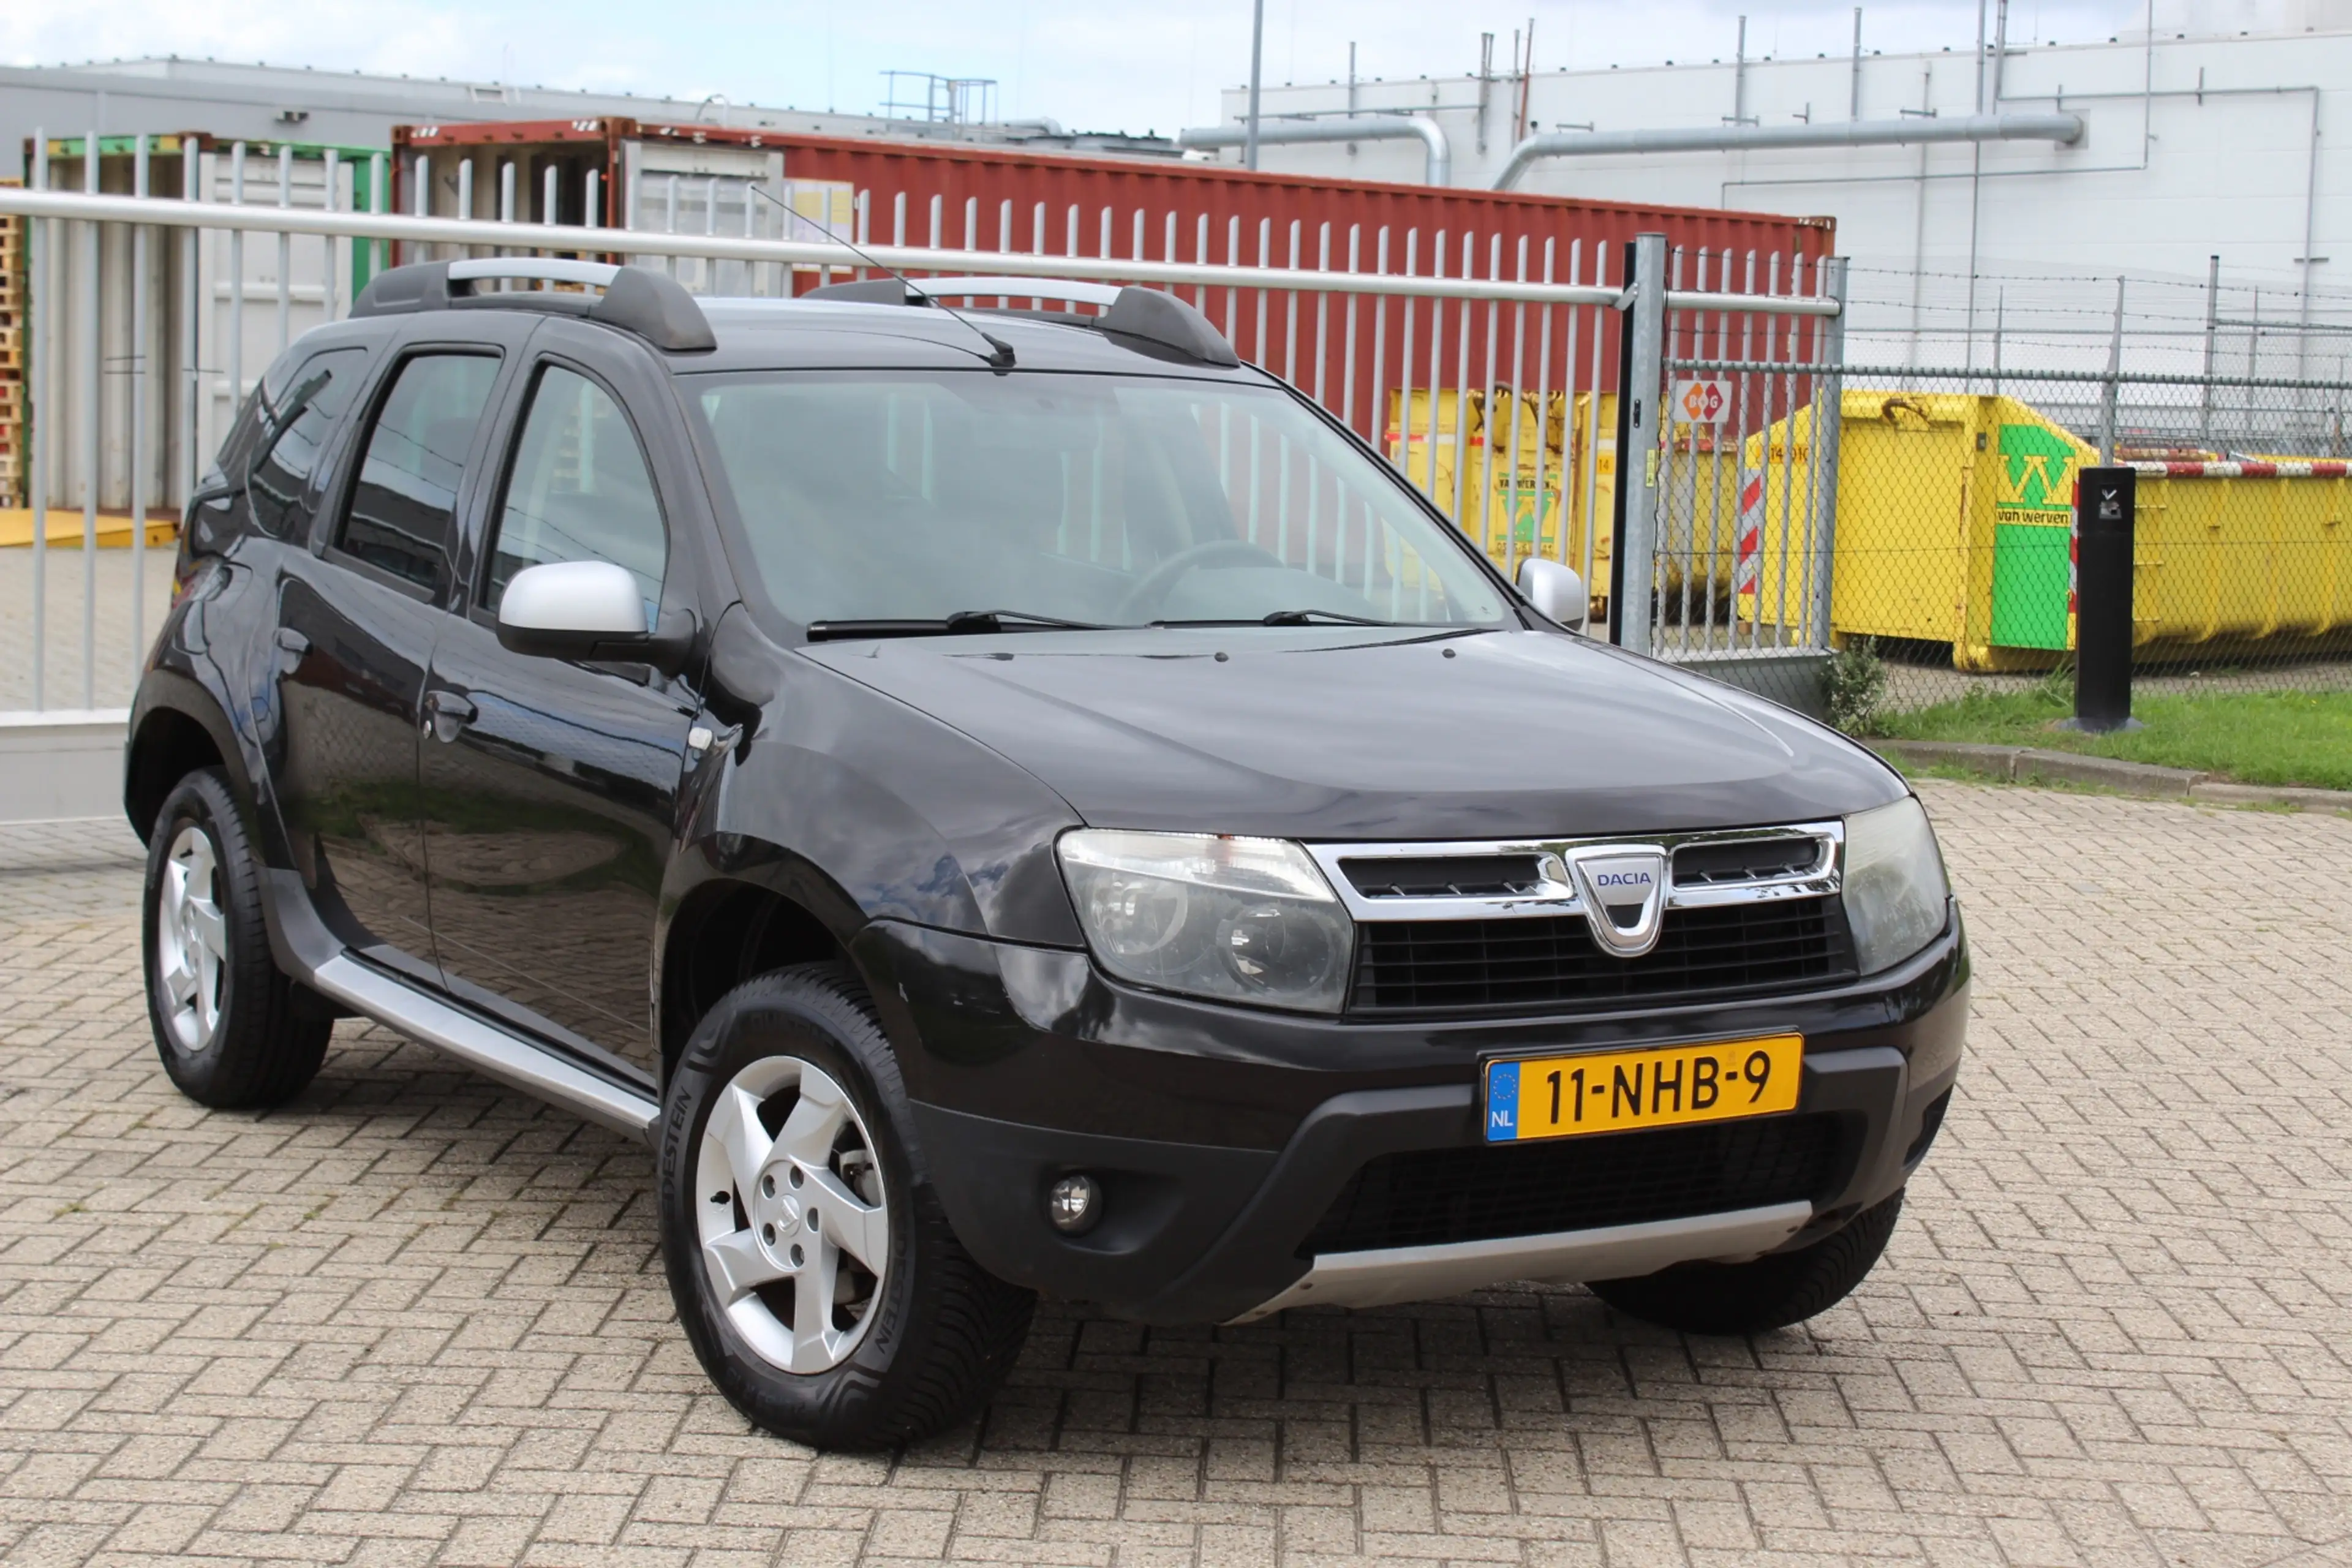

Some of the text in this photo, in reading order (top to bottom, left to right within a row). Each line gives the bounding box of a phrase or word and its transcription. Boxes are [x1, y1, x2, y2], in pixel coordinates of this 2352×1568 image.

[1997, 511, 2068, 524] van werven
[1597, 872, 1651, 886] DACIA
[1547, 1049, 1771, 1125] 11-NHB-9
[1491, 1110, 1514, 1128] NL
